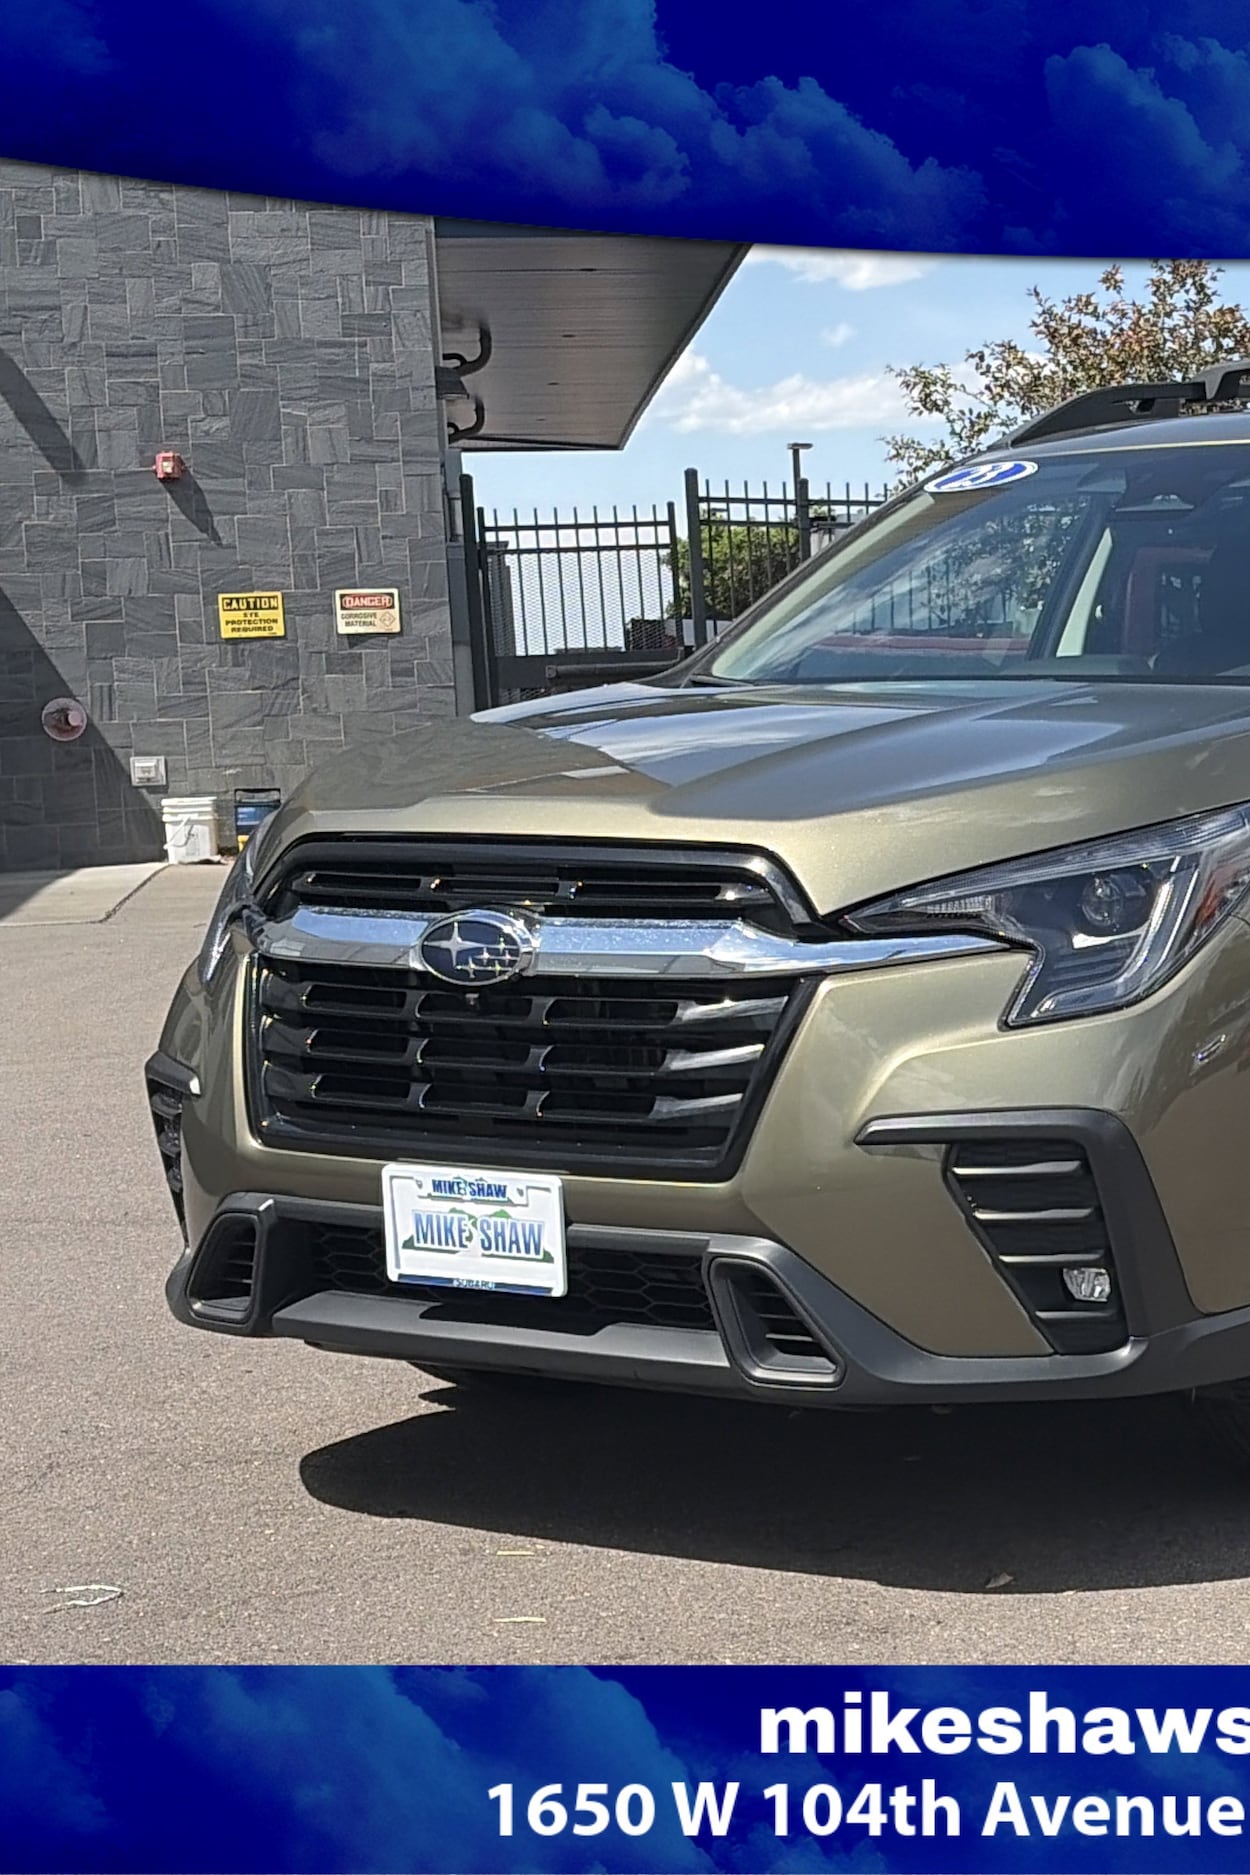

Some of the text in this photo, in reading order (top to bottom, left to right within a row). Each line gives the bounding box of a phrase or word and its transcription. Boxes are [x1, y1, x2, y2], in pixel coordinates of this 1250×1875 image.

[222, 597, 278, 610] CAUTION
[344, 596, 390, 607] DANGER
[341, 612, 377, 620] CORROSIVE
[225, 618, 278, 626] PROTECTION
[230, 625, 274, 633] REQUIRED
[432, 1178, 508, 1199] MIKE SHAW
[414, 1212, 543, 1256] MIKE SHAW
